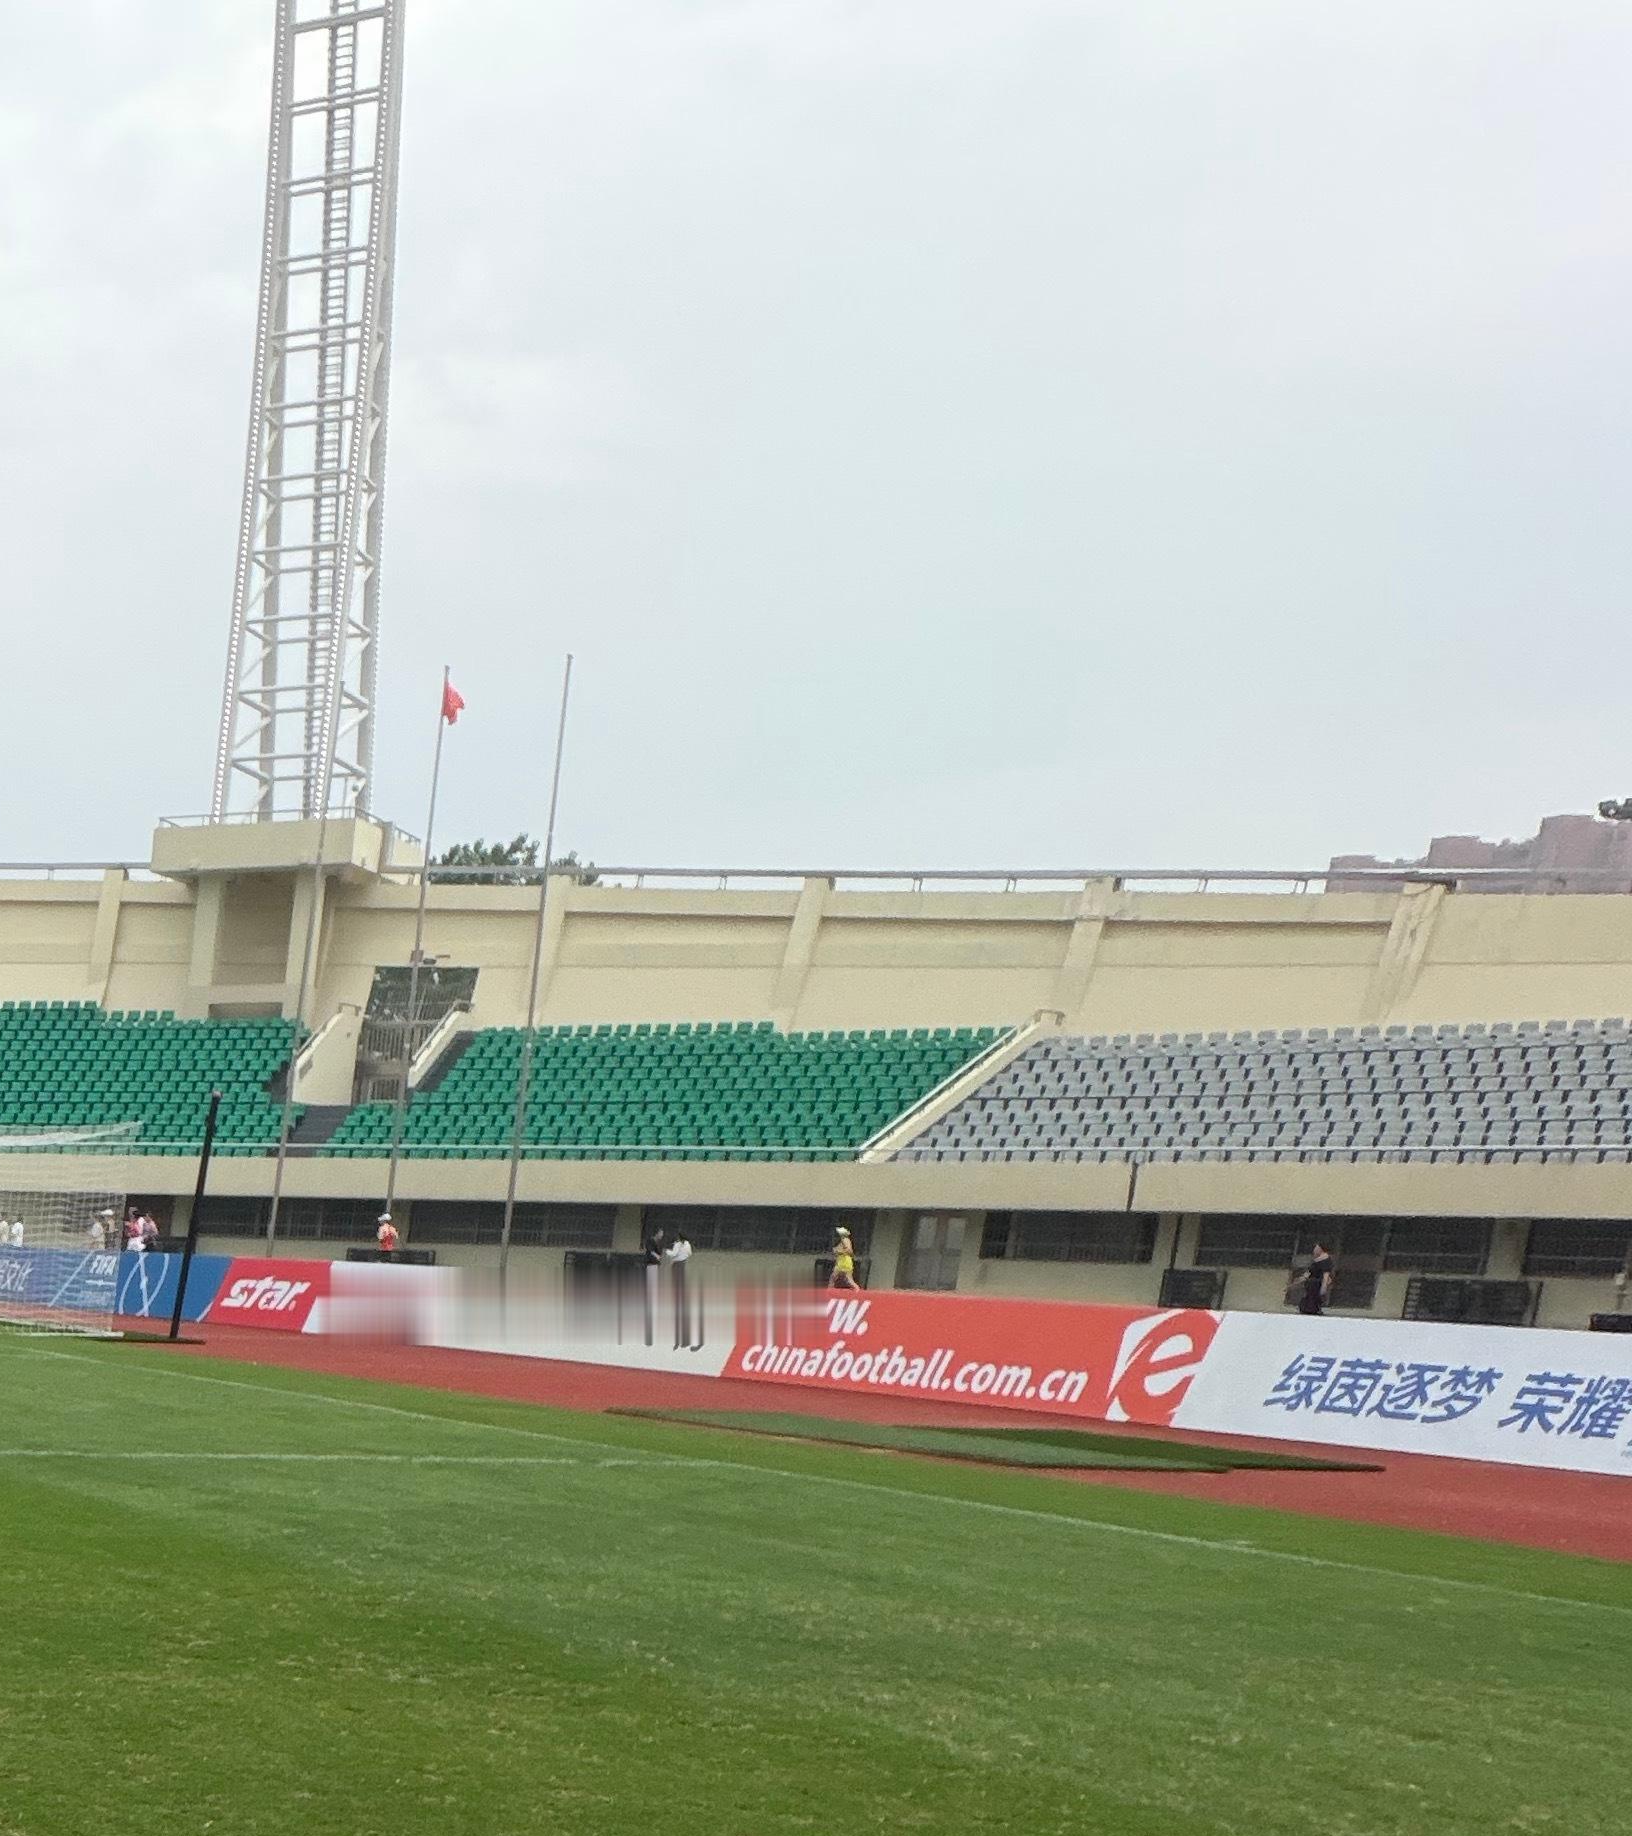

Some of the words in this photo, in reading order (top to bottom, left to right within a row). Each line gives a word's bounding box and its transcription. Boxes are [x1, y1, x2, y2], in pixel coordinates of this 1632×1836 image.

[741, 1338, 1089, 1403] chinafootball.com.cn
[1263, 1353, 1503, 1424] 绿茵逐梦
